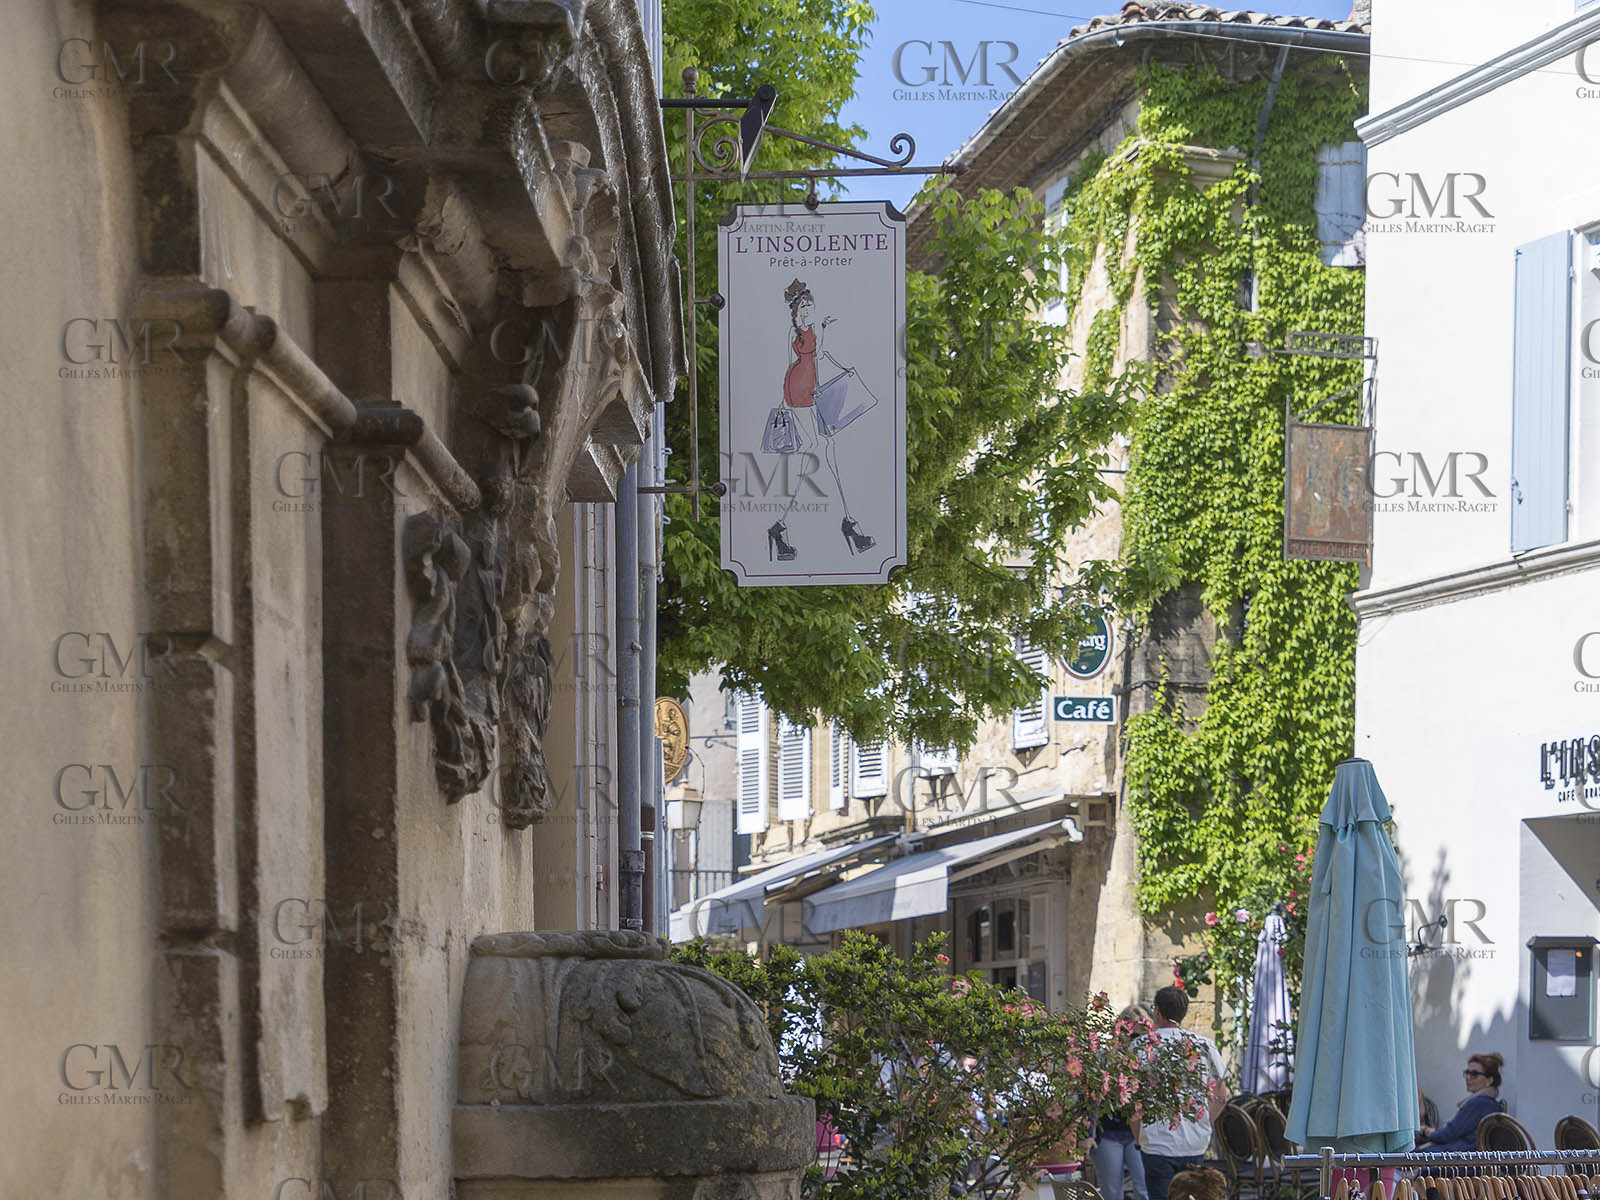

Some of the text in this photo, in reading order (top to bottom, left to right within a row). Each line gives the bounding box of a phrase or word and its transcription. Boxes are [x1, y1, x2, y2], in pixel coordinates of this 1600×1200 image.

[735, 233, 889, 254] L'INSOLENTE
[769, 255, 853, 268] Prêt-à-Porter
[1056, 700, 1111, 720] Café
